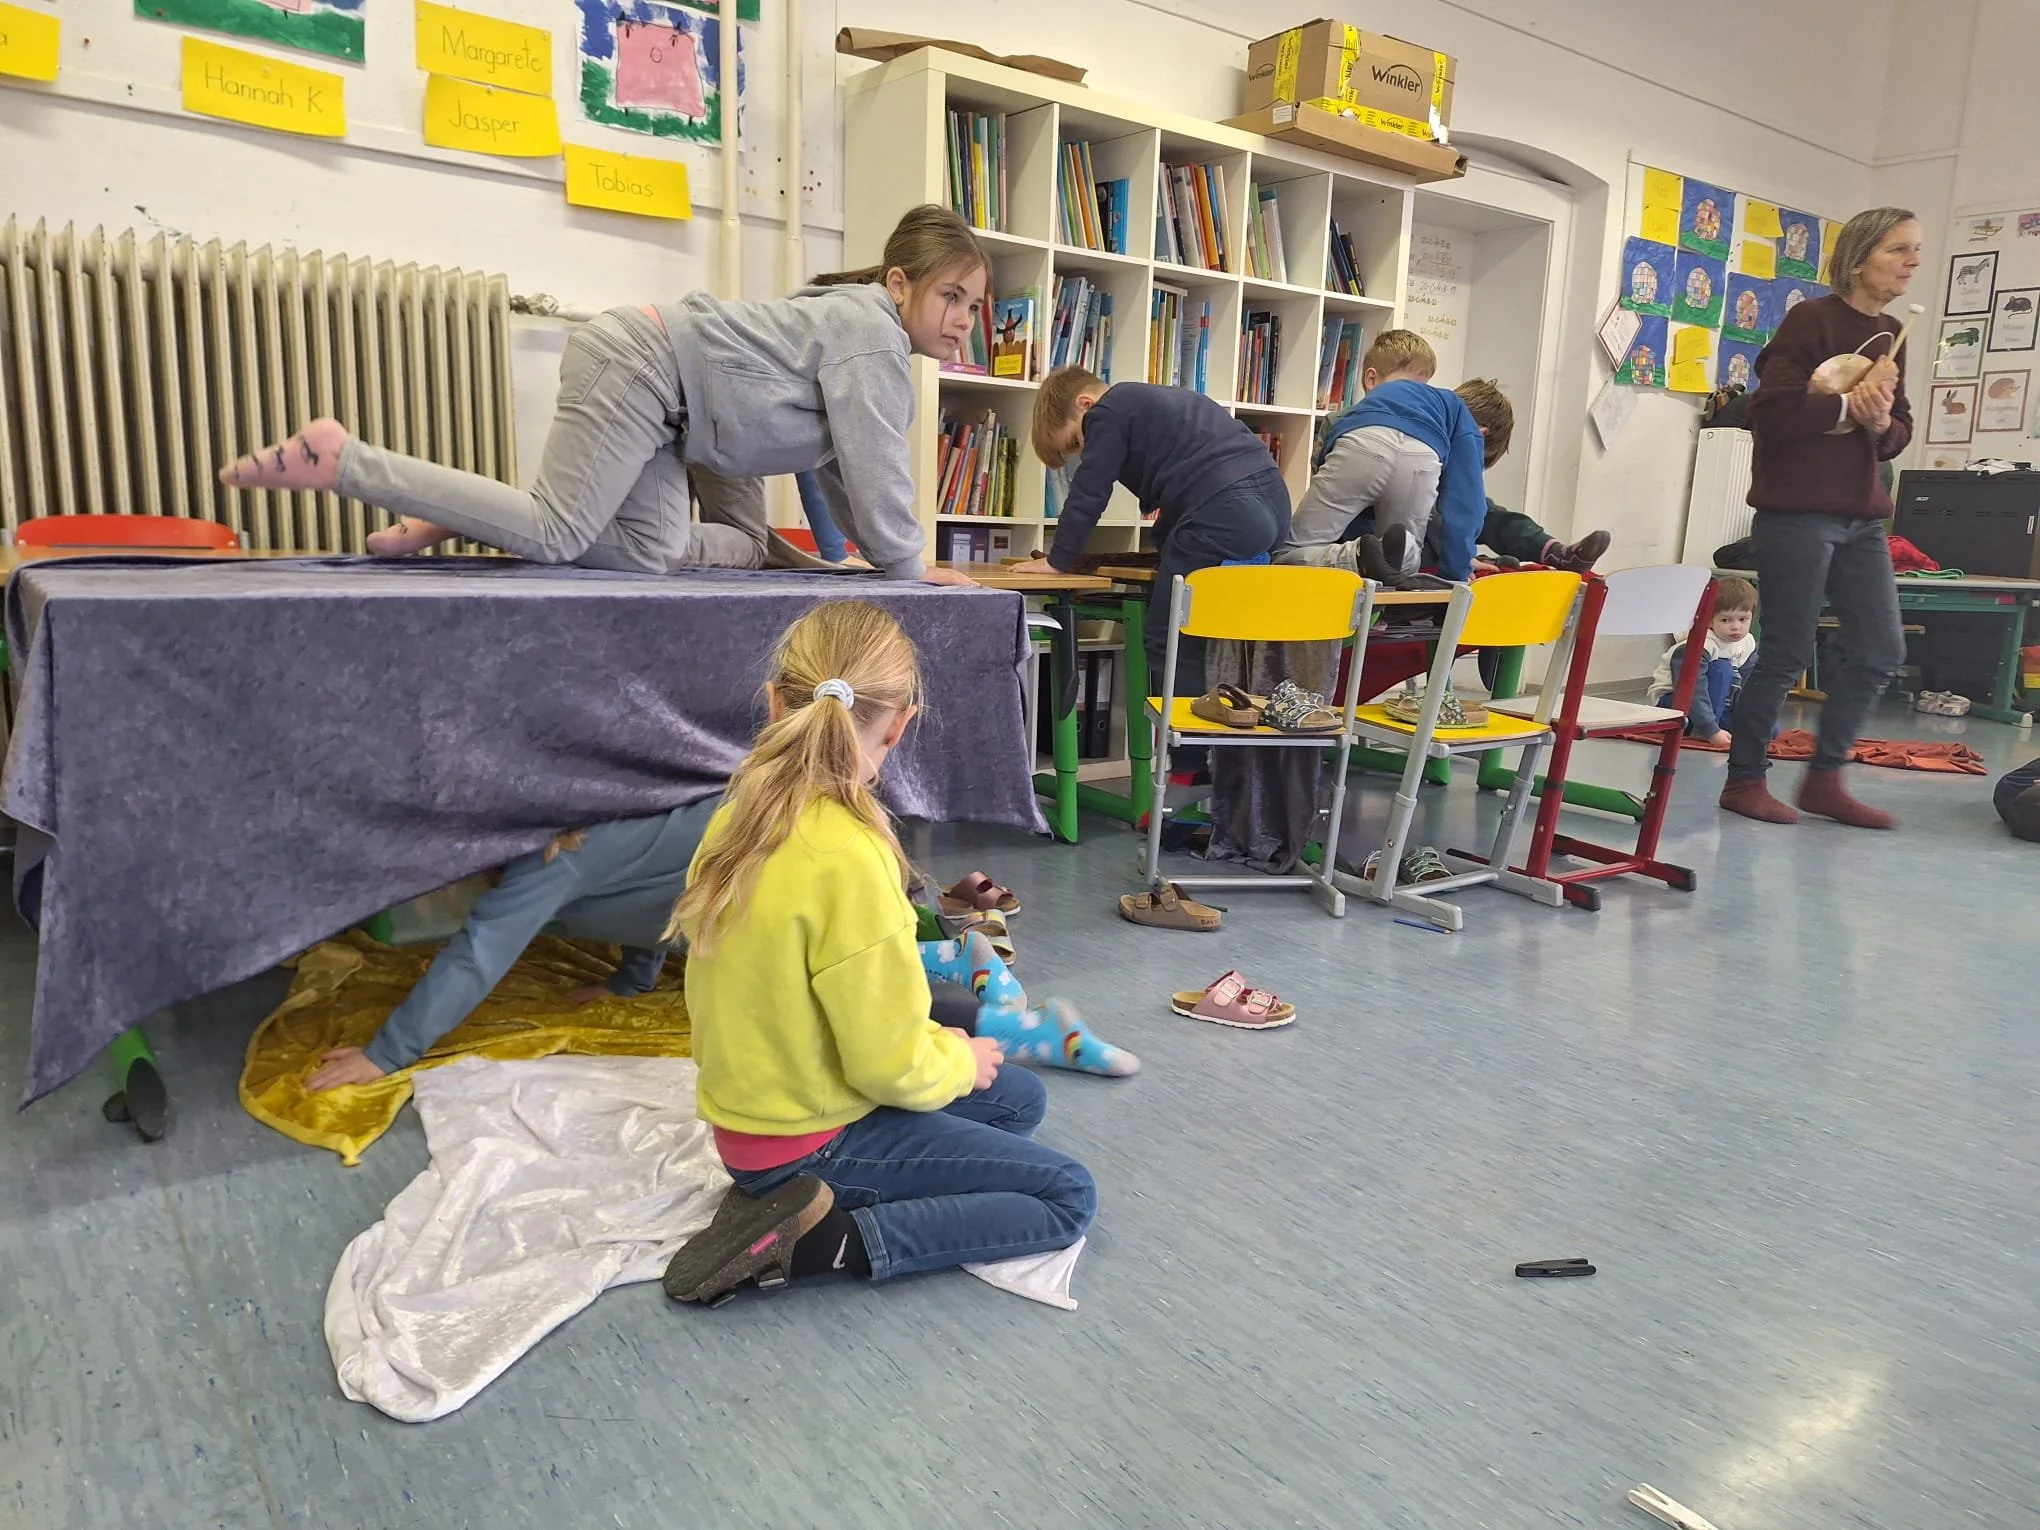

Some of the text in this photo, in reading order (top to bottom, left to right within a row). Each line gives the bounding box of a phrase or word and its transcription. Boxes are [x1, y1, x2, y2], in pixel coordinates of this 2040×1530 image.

[442, 23, 543, 74] Margarete
[204, 61, 294, 109] Hannah
[1248, 68, 1276, 82] Winkler
[1371, 64, 1421, 93] Winkler
[448, 99, 521, 143] Jasper
[1380, 117, 1404, 131] Winkler
[588, 162, 655, 199] Tobias
